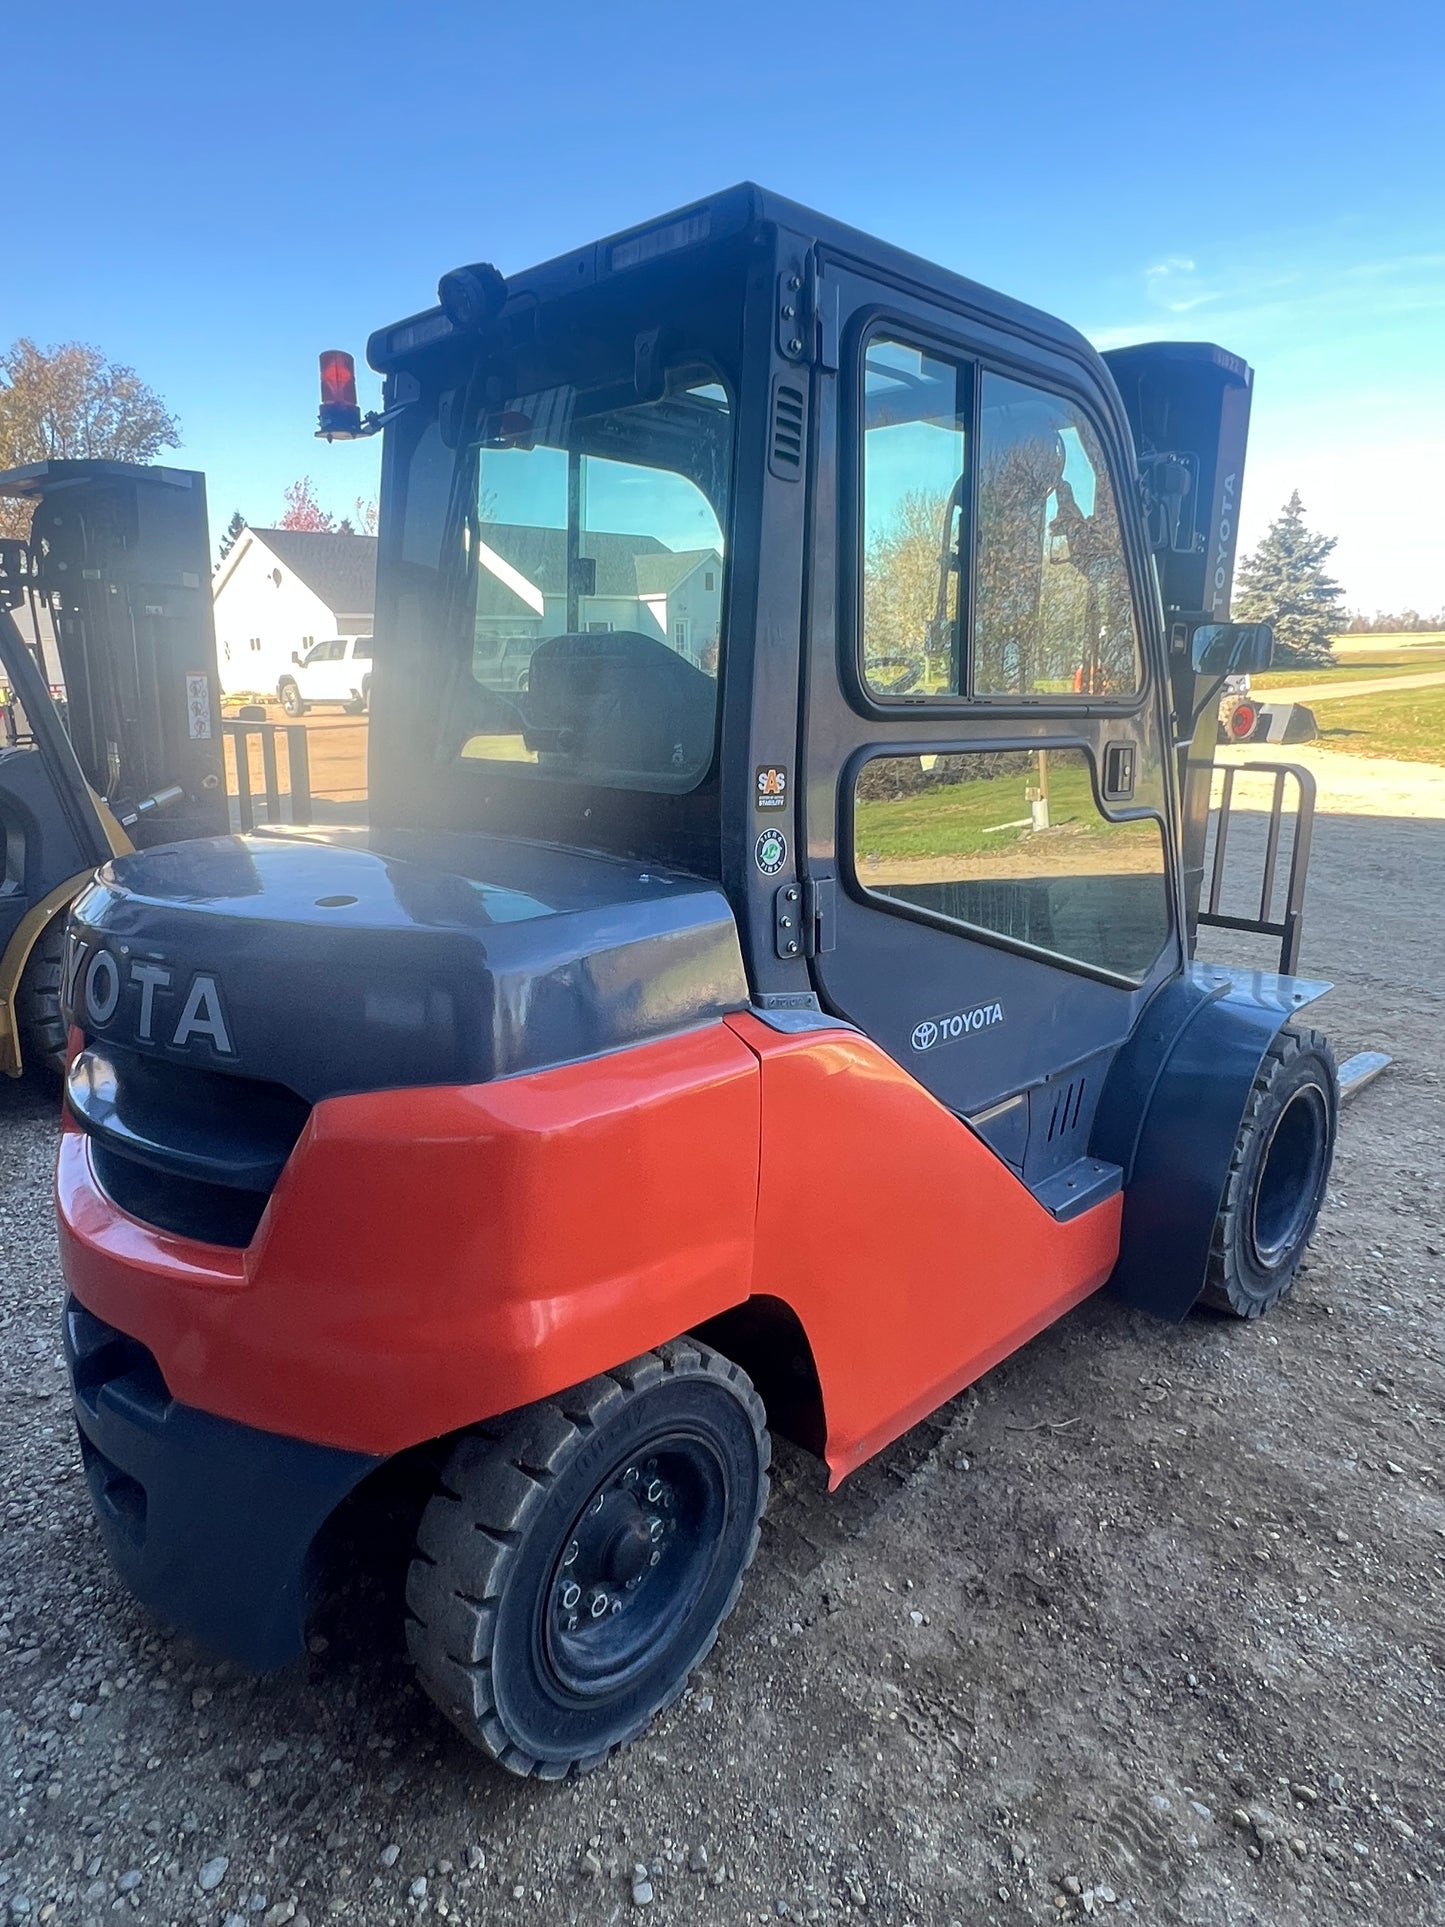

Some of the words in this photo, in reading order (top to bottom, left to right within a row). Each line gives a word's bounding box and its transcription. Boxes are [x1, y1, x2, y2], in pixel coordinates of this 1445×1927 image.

[1212, 472, 1236, 611] TOYOTA
[758, 769, 785, 794] SAS
[61, 926, 232, 1053] YOTA
[940, 1003, 1003, 1040] TOYOTA
